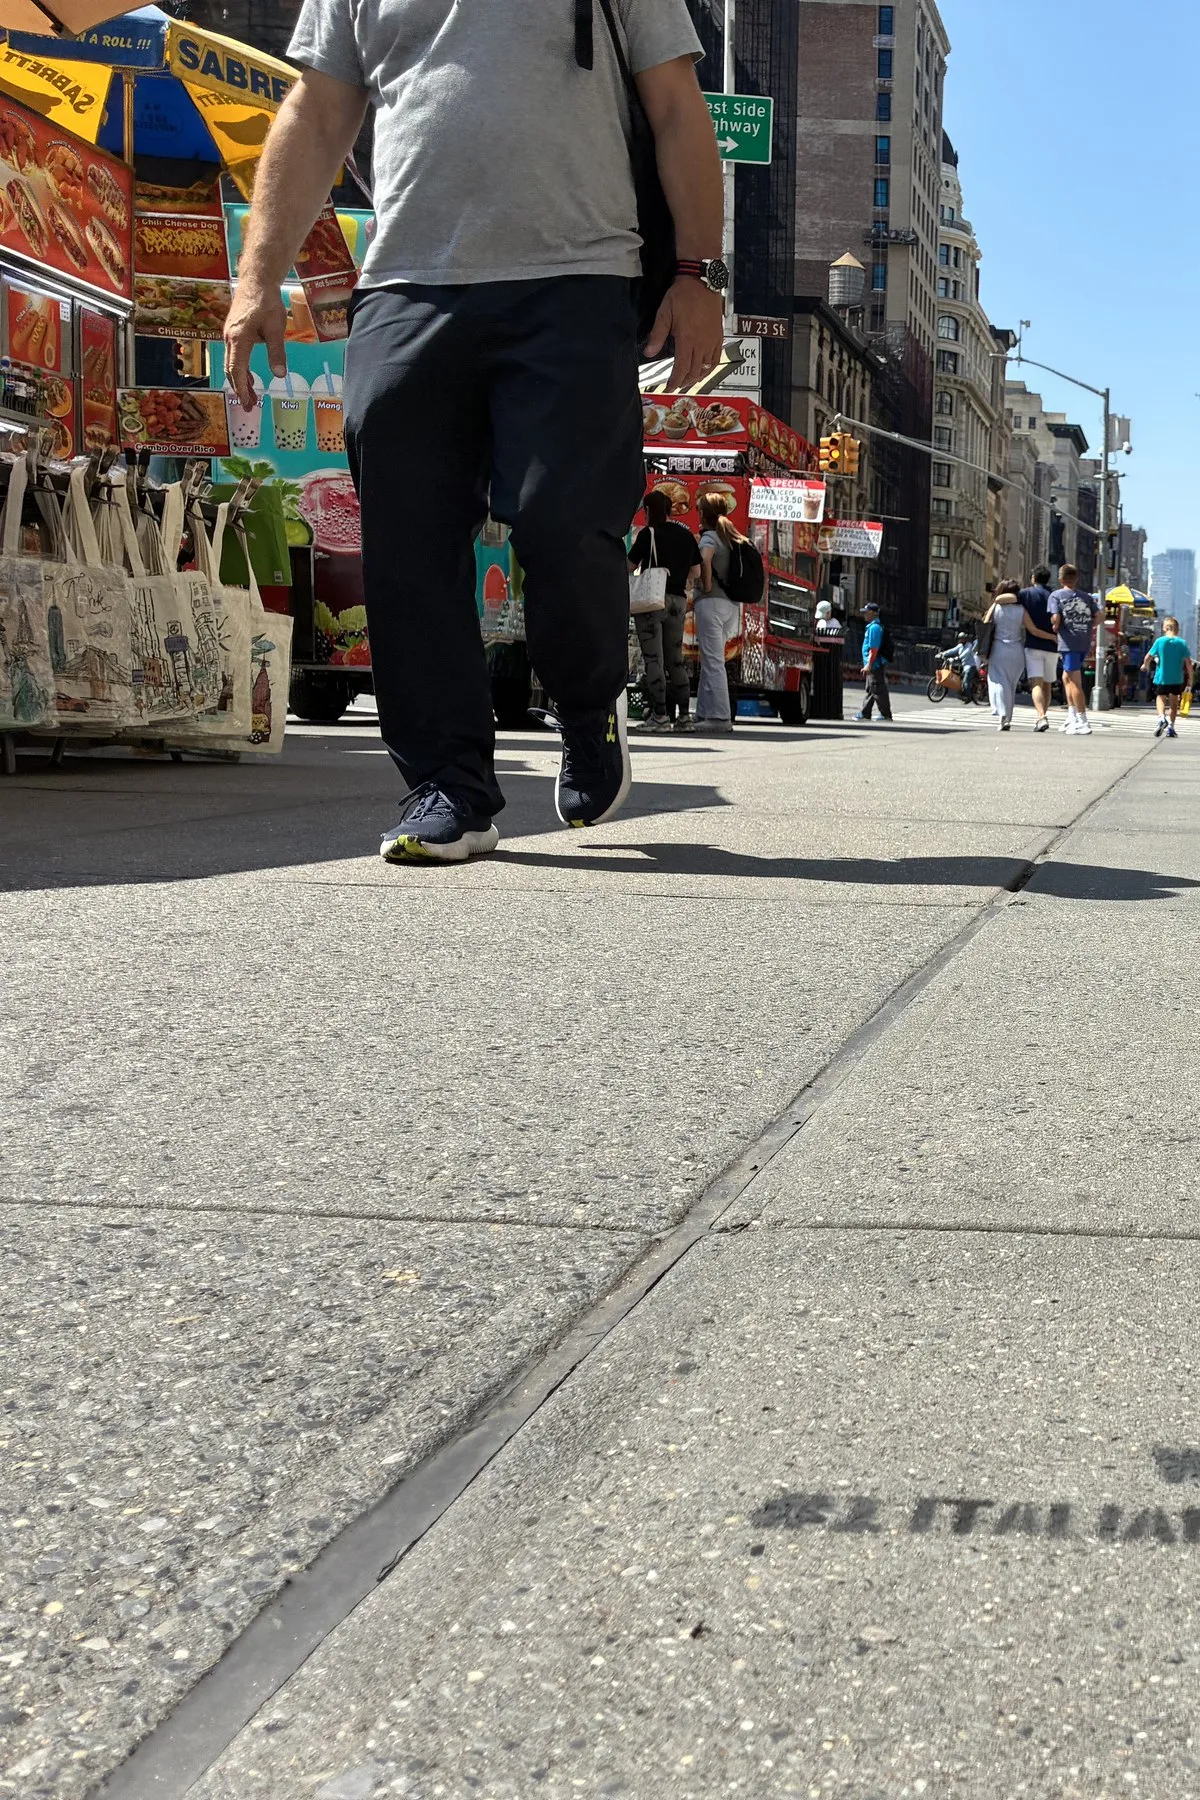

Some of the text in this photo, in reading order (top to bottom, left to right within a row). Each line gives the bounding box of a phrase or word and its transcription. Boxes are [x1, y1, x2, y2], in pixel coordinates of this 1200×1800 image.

[89, 33, 98, 45] A
[102, 35, 133, 48] ROLL
[179, 38, 288, 102] SABRE
[706, 101, 766, 117] est Side
[712, 118, 760, 137] ghway
[164, 219, 198, 228] Cheese
[200, 221, 218, 230] Dog
[158, 327, 221, 339] Chicken Sala
[742, 320, 784, 336] W 23 St
[730, 366, 756, 376] OUTE
[281, 401, 343, 411] Kiwi Mang
[135, 442, 216, 454] Combo Over Rice
[668, 456, 691, 471] FEE
[693, 458, 735, 472] PLACE
[769, 478, 808, 488] SPECIAL
[751, 494, 778, 502] COFFEE
[750, 502, 774, 510] SMALL
[836, 520, 868, 530] SPECIAL
